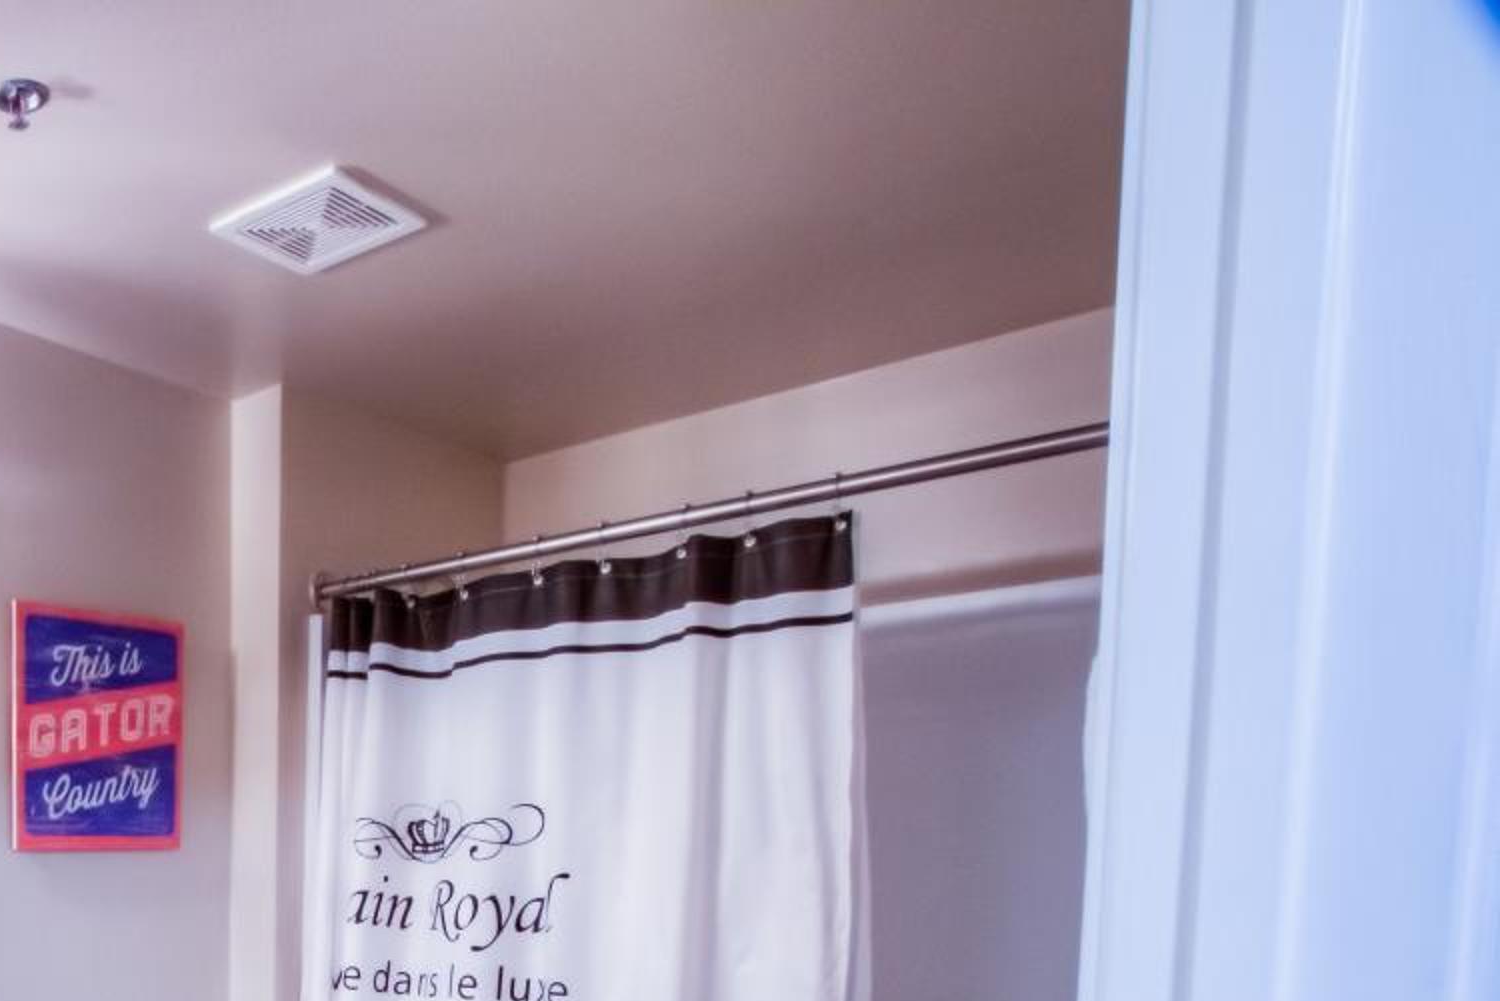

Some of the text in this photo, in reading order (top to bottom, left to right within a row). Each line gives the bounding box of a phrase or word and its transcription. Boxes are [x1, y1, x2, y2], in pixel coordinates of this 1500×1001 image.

[51, 641, 143, 687] This is
[28, 693, 175, 757] GATOR
[42, 764, 159, 820] Country
[448, 963, 477, 1000] le
